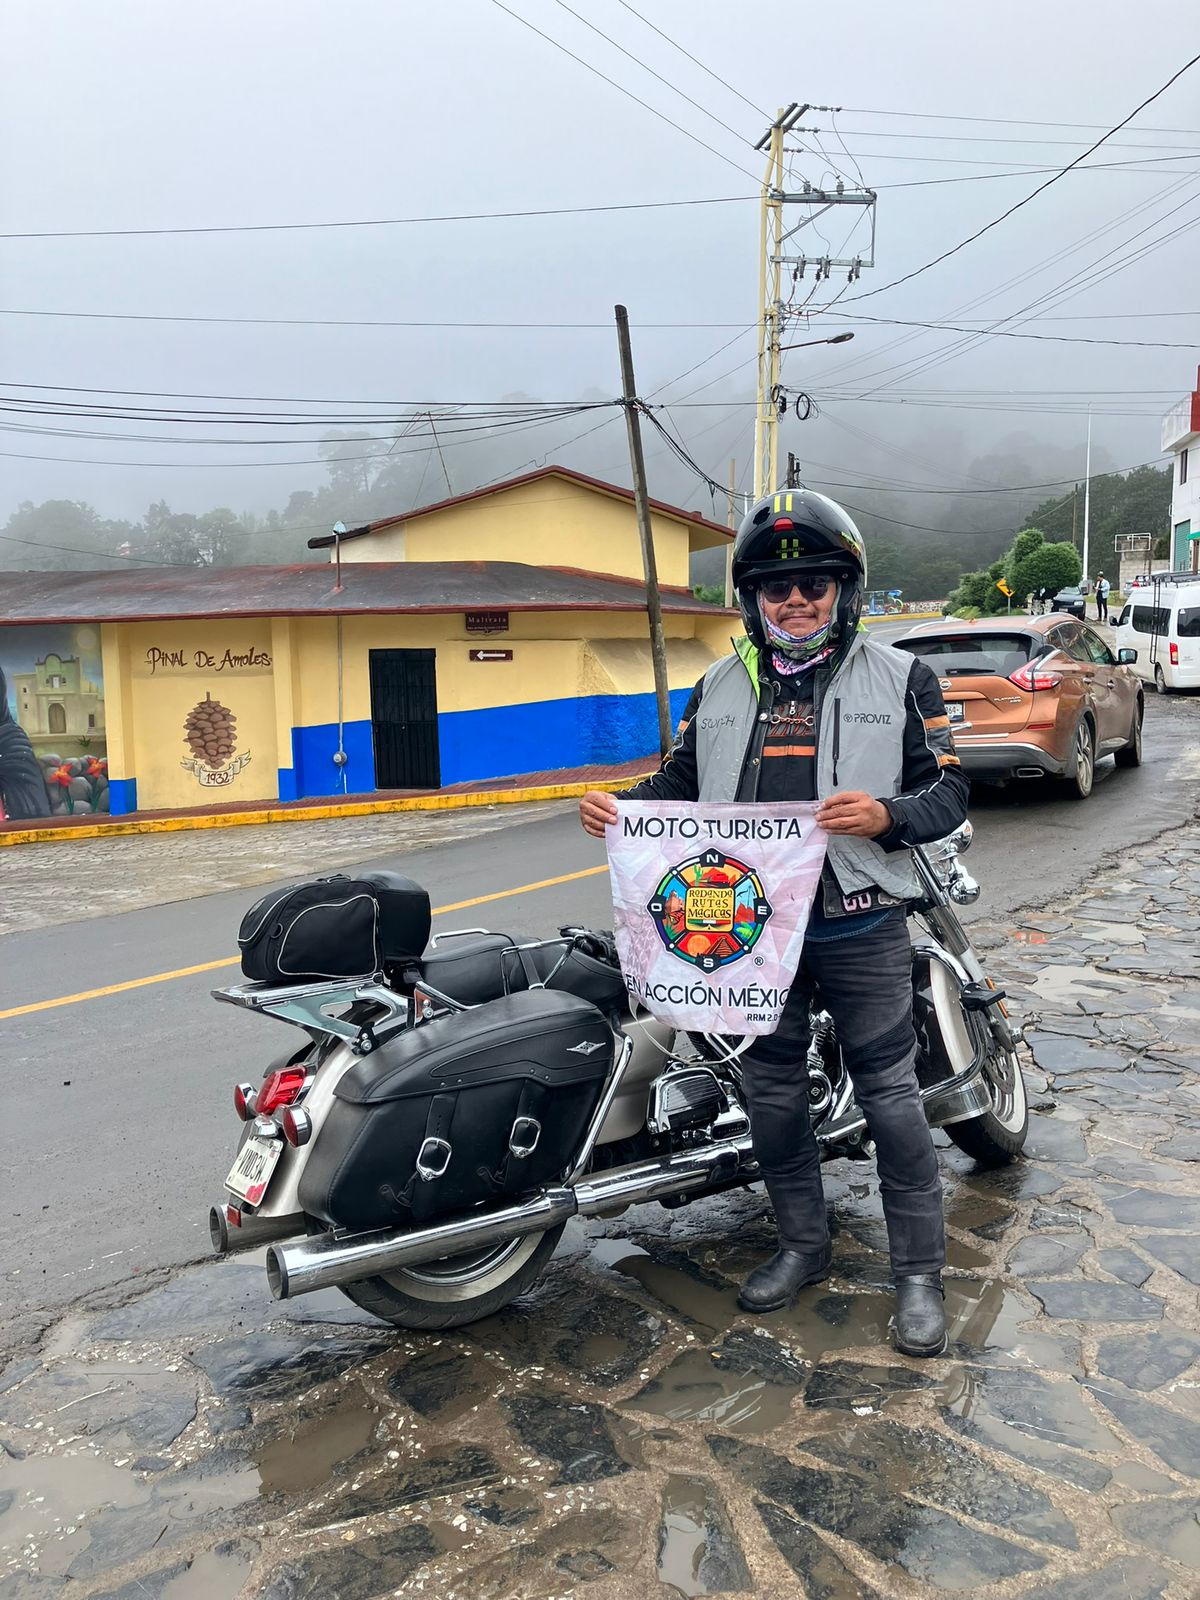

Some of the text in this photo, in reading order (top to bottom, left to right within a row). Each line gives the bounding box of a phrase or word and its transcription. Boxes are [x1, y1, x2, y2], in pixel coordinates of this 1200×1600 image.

[854, 713, 892, 725] PROVIZ
[205, 771, 230, 785] 1932
[623, 816, 802, 839] MOTO TURISTA
[706, 854, 719, 864] N
[757, 905, 768, 915] E
[703, 957, 714, 968] S
[626, 973, 642, 996] EN
[645, 980, 722, 1007] ACCIÓN
[747, 1013, 766, 1022] RRM
